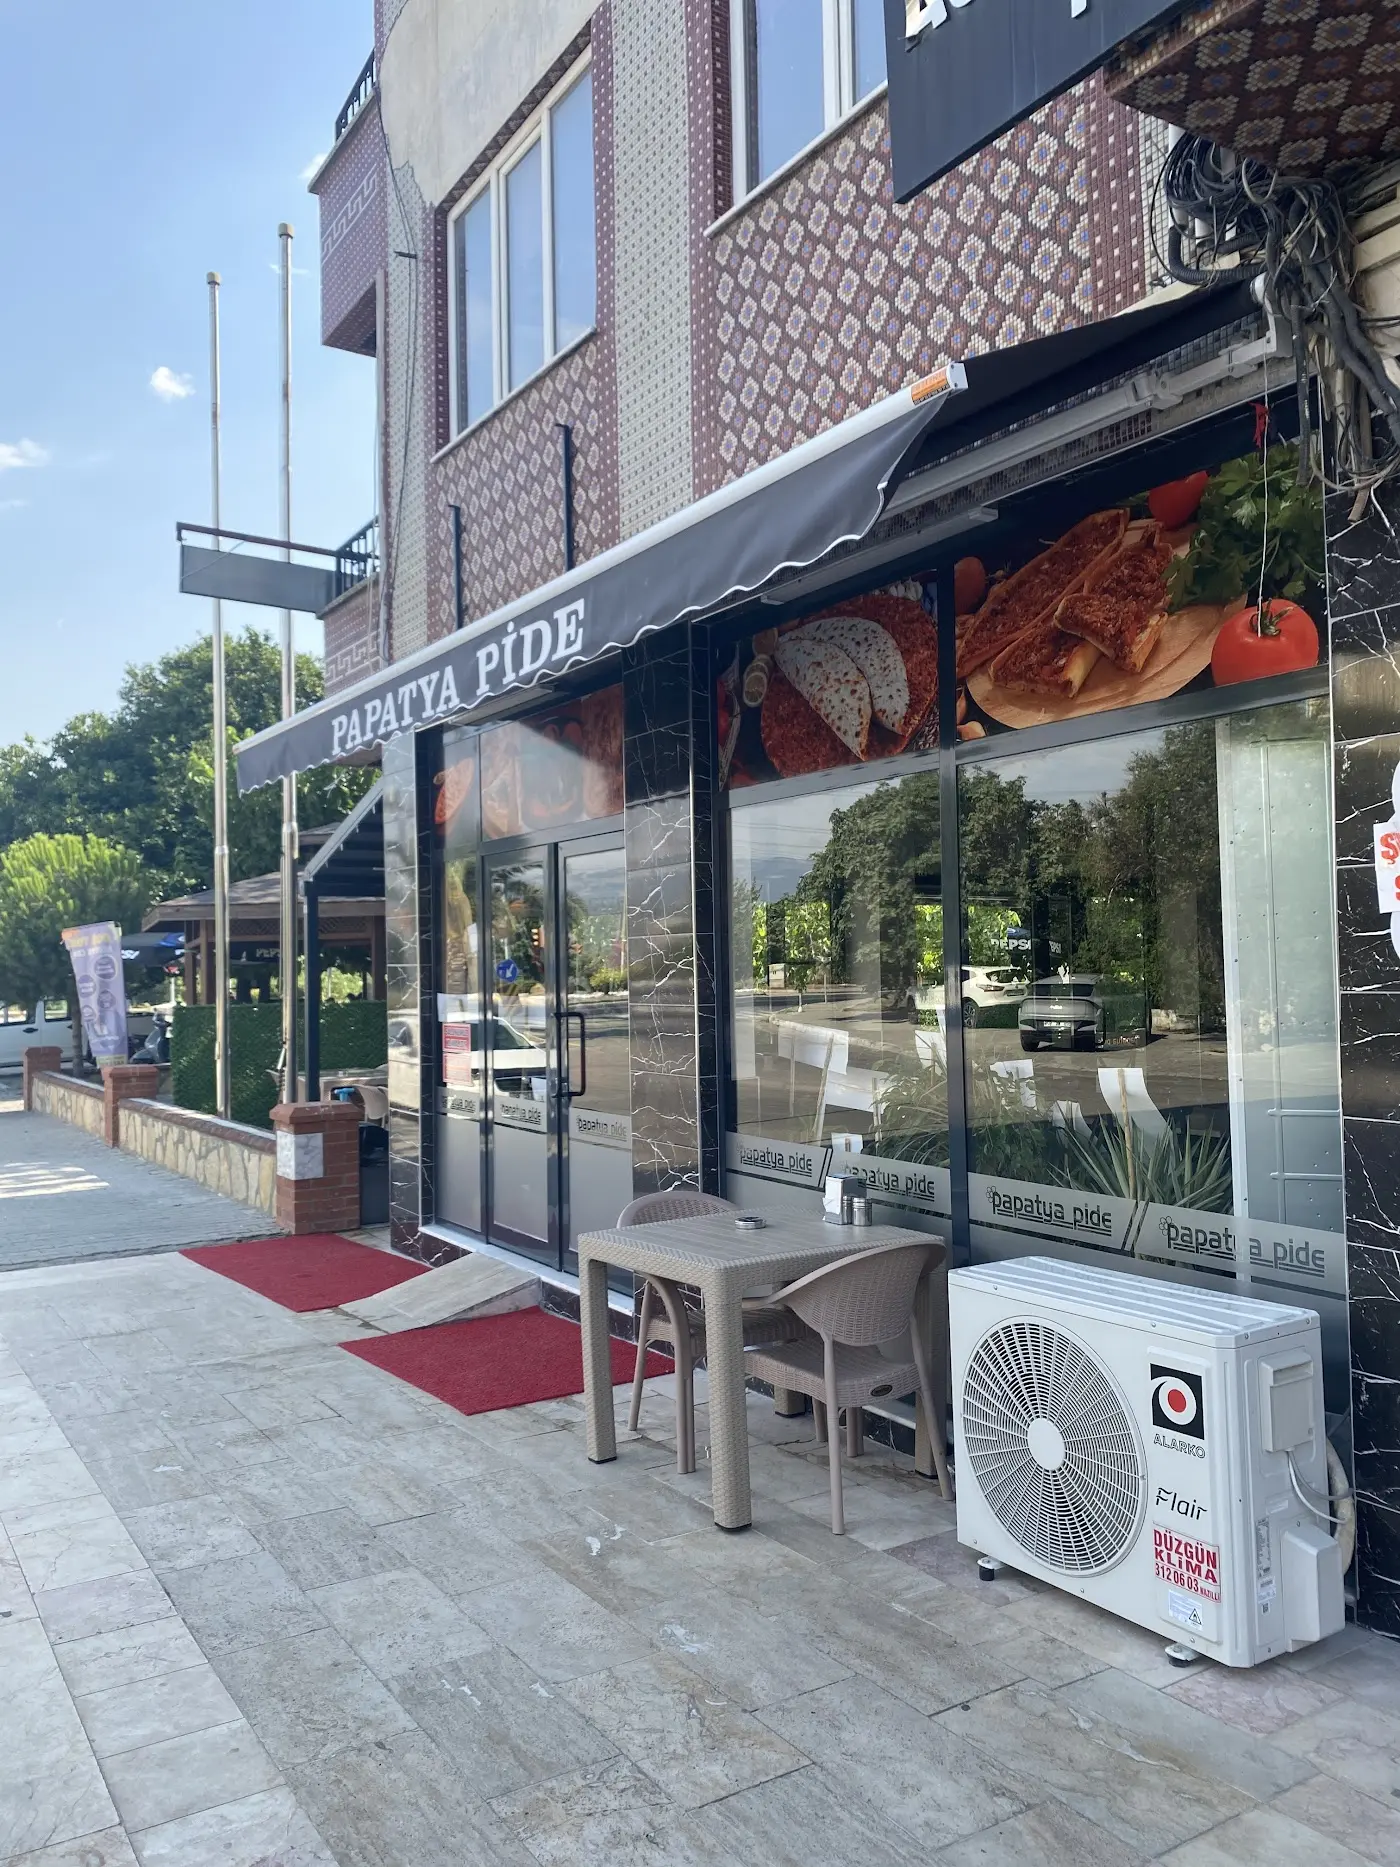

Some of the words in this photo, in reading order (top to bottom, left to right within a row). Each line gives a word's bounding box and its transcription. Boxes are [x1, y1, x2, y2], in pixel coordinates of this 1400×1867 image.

[331, 665, 460, 756] PAPATYA
[476, 598, 585, 696] PİDE
[528, 1107, 541, 1123] pide
[578, 1117, 608, 1136] papatya
[611, 1123, 627, 1138] pide
[740, 1147, 784, 1169] papatya
[788, 1153, 812, 1173] pide
[906, 1173, 935, 1196] pide
[993, 1191, 1065, 1224] papatya
[1074, 1202, 1112, 1230] pide
[1168, 1221, 1262, 1256] papata
[1274, 1238, 1325, 1269] pide
[1153, 1433, 1206, 1459] ALARKO
[1156, 1487, 1208, 1520] Flair
[1153, 1529, 1217, 1570] DÜZGÜN
[1155, 1562, 1172, 1581] 312
[1173, 1570, 1185, 1587] 06
[1187, 1577, 1199, 1592] 03
